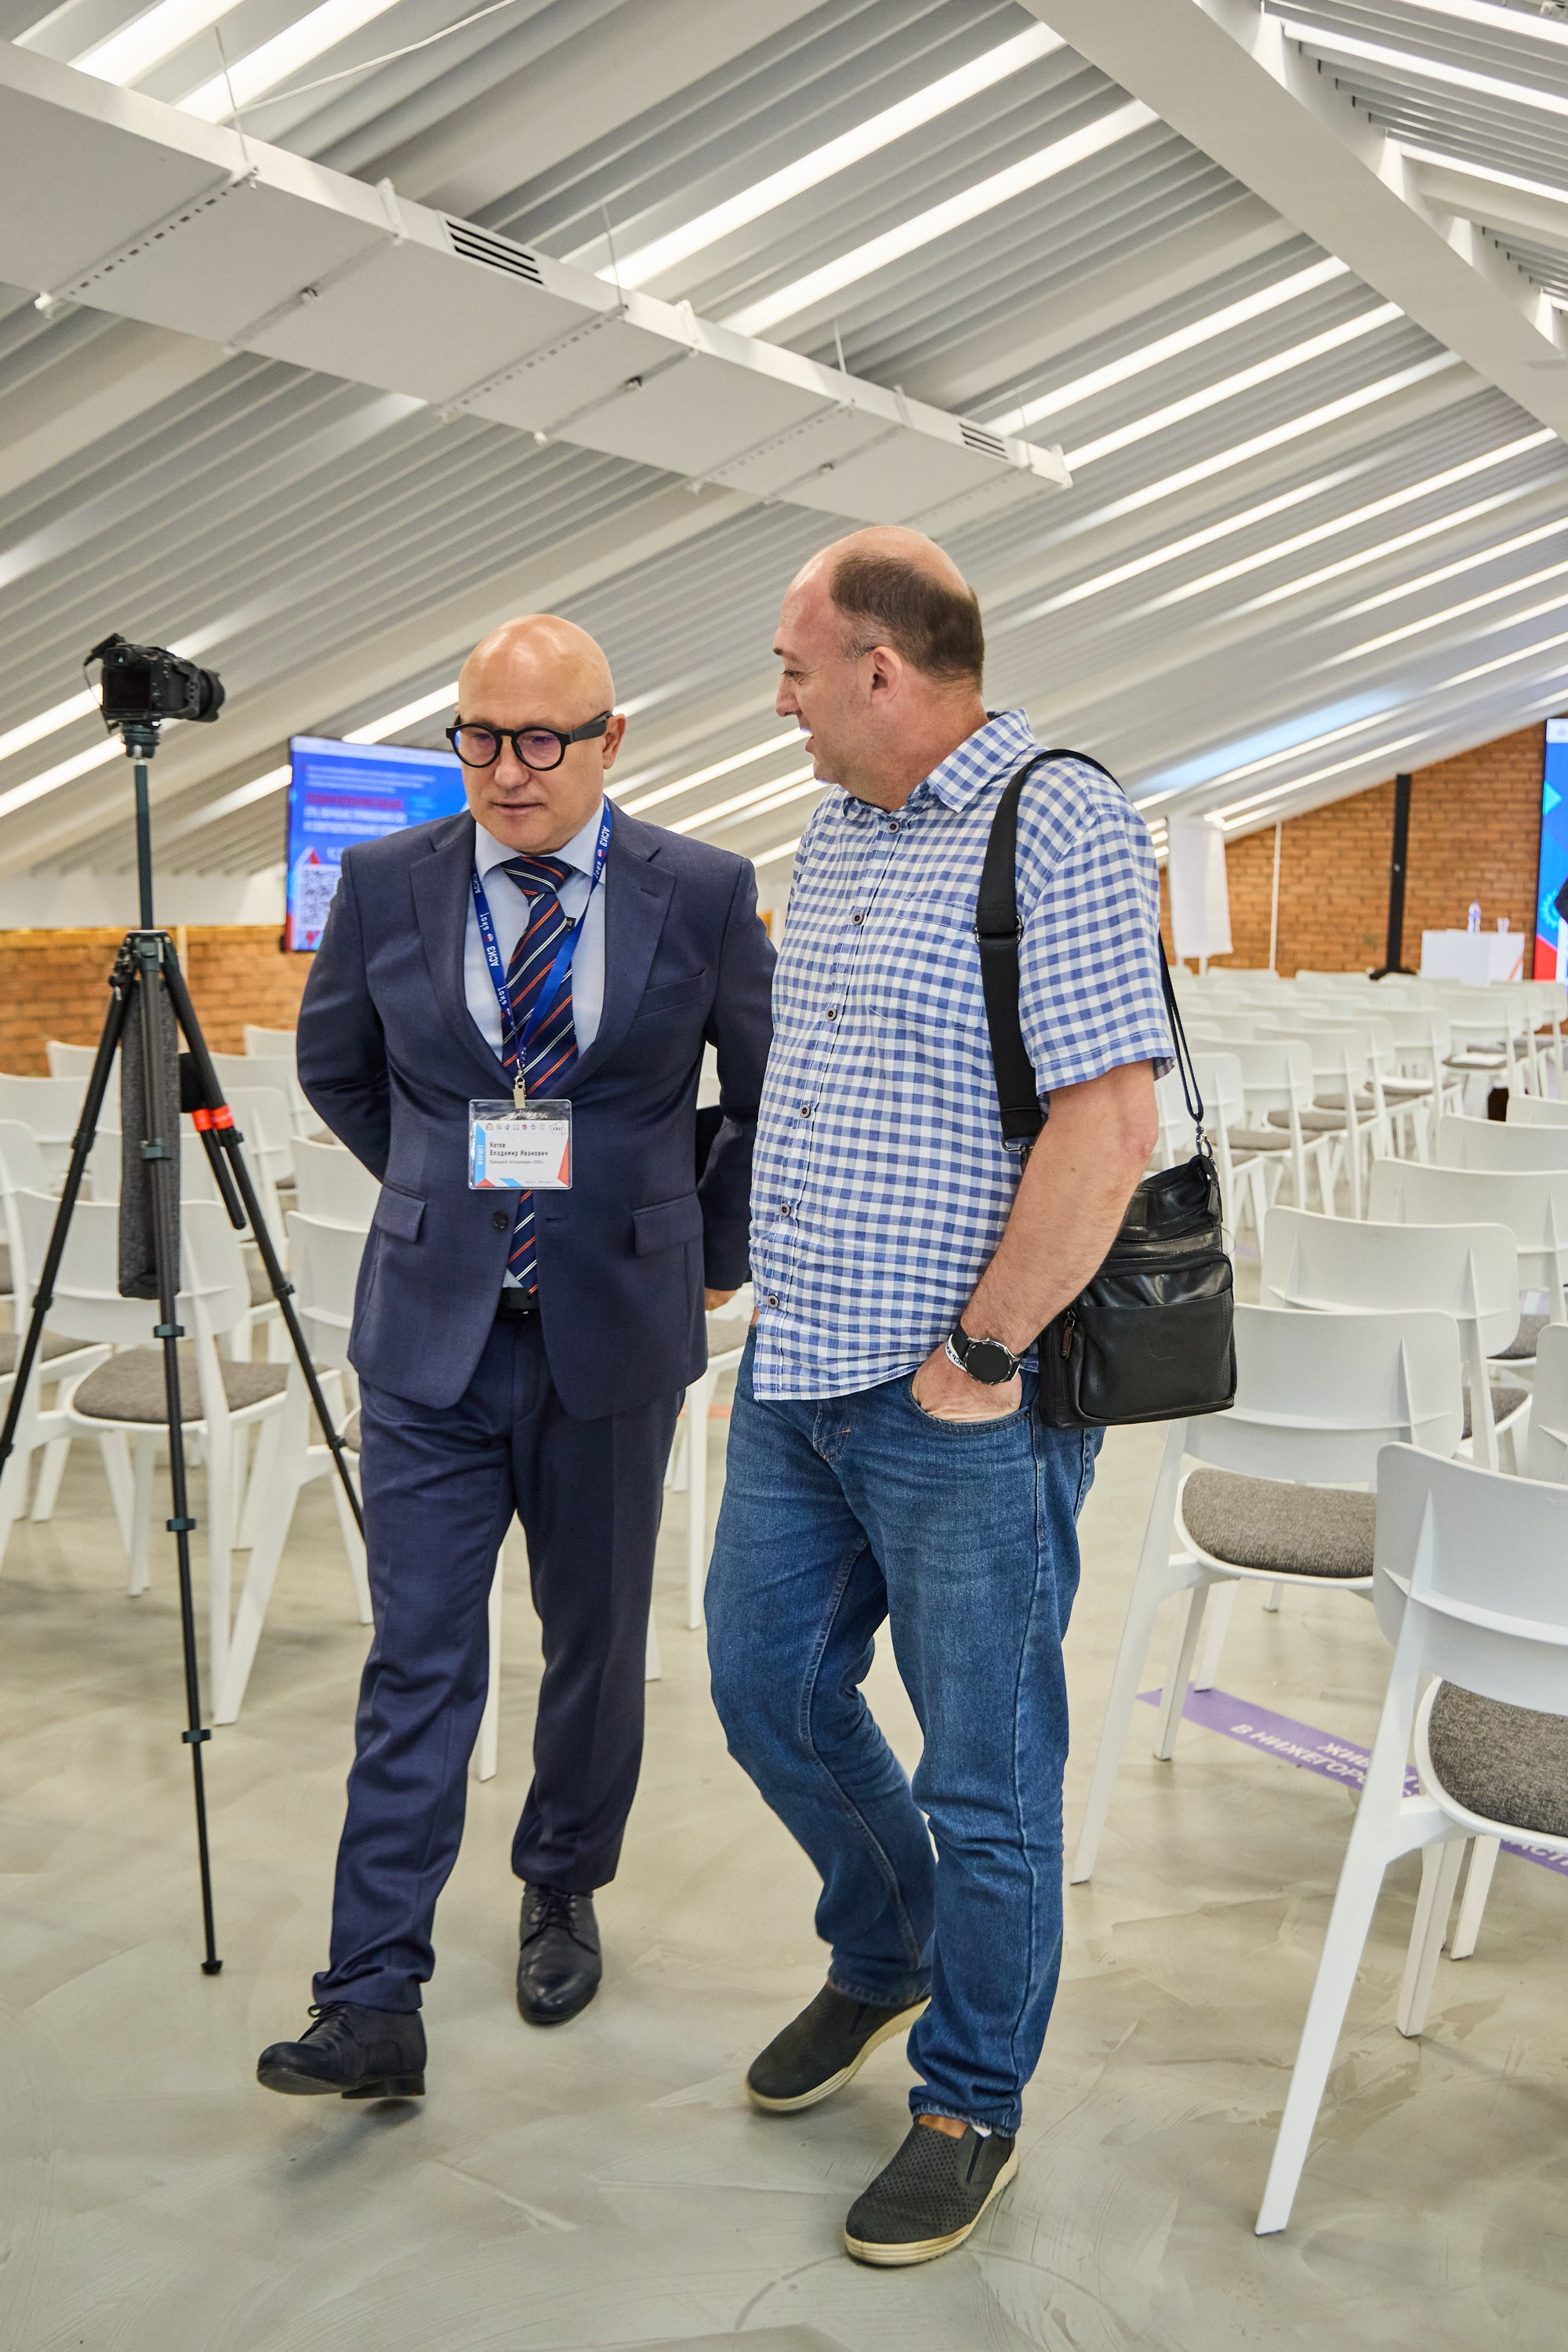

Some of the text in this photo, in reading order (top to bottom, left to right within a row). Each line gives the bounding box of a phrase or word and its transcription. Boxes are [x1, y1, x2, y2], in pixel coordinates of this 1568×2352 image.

[599, 826, 610, 848] АСИЗ
[472, 873, 481, 894] АСИЗ
[486, 946, 499, 967] АСИЗ
[1229, 1722, 1254, 1735] В
